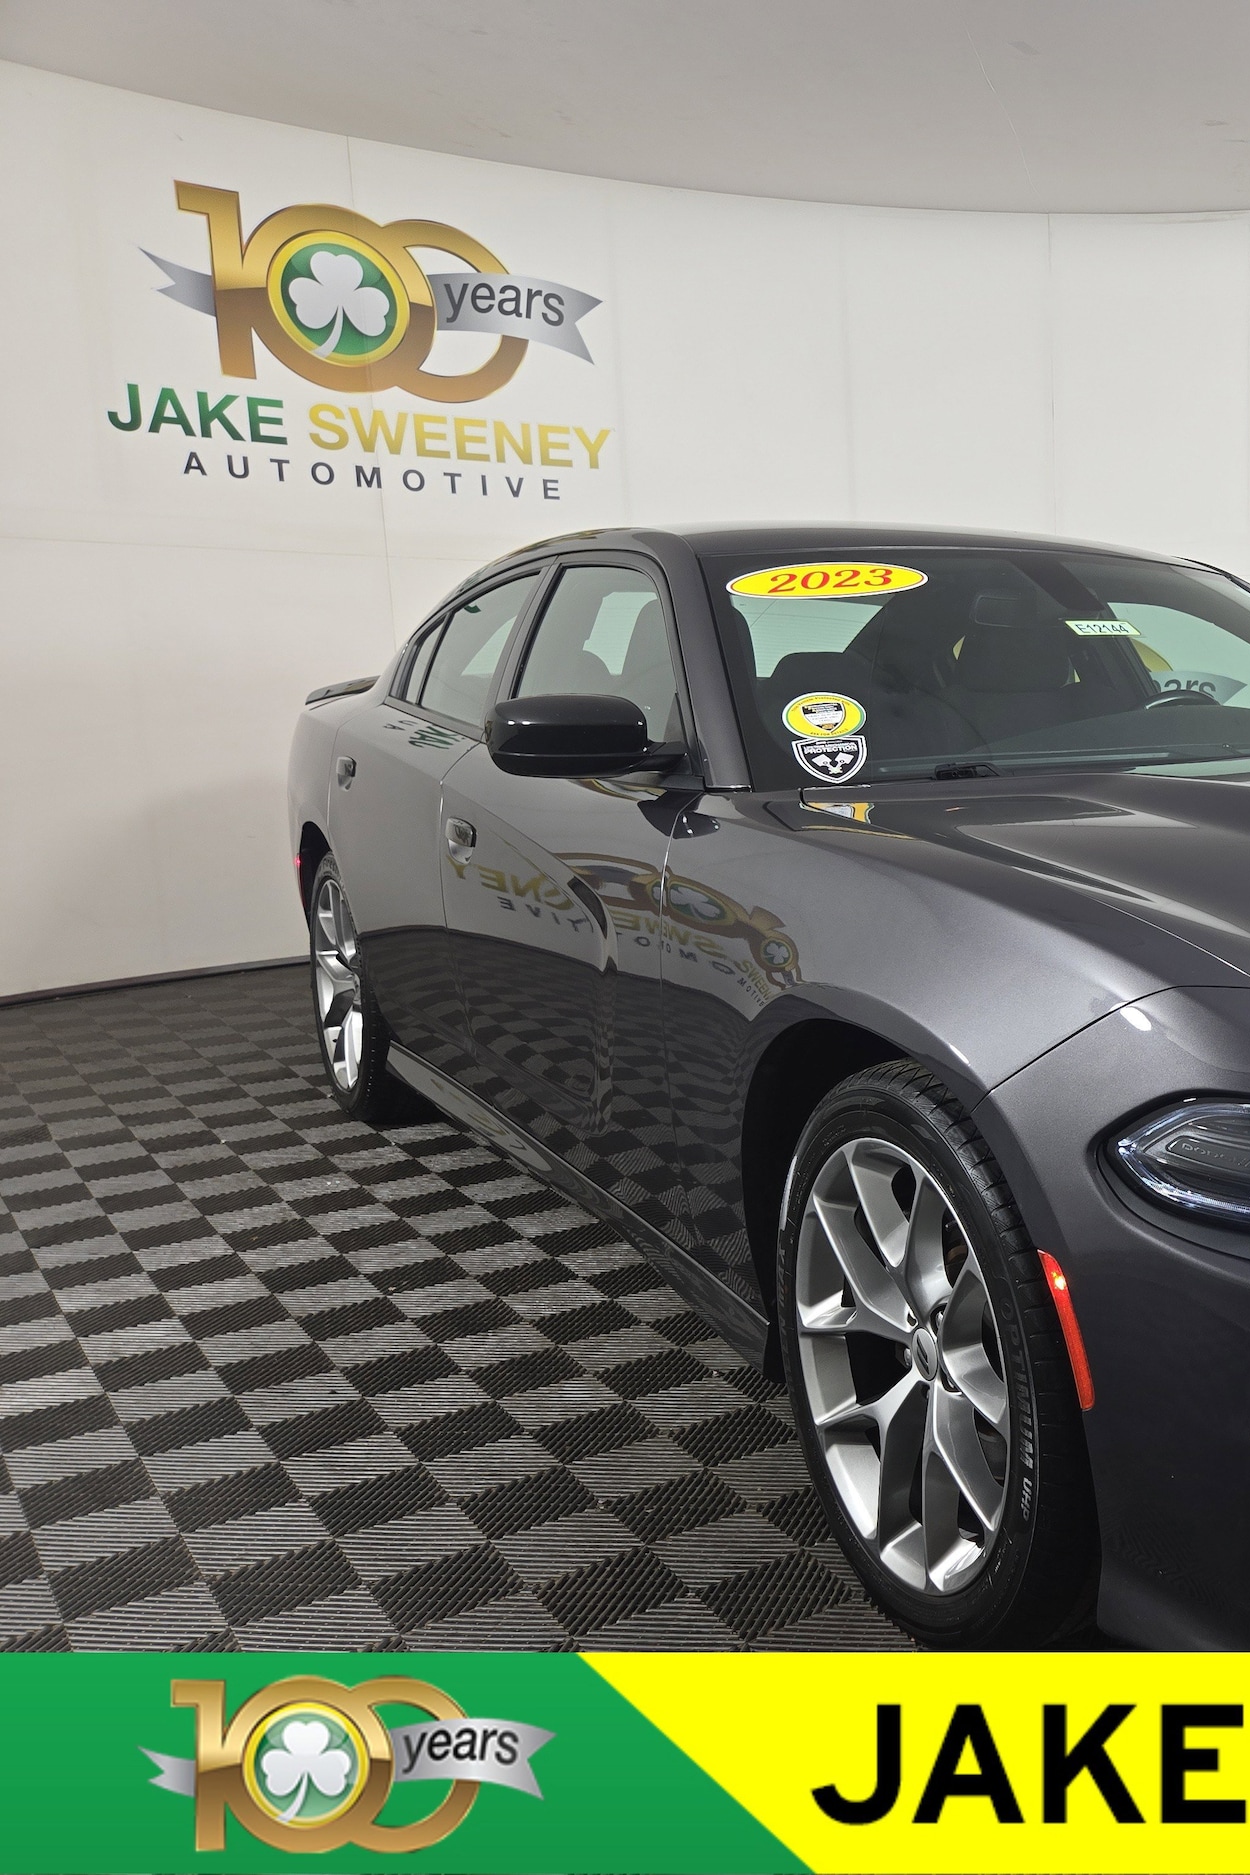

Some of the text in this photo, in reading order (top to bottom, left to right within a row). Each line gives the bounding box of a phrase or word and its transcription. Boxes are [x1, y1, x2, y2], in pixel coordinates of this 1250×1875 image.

[173, 179, 566, 404] 100 years
[107, 383, 612, 470] JAKE SWEENEY
[183, 450, 561, 500] AUTOMOTIVE
[767, 568, 893, 594] 2023
[1074, 623, 1130, 634] E12144
[1000, 1301, 1034, 1523] OPTIMUM UHP
